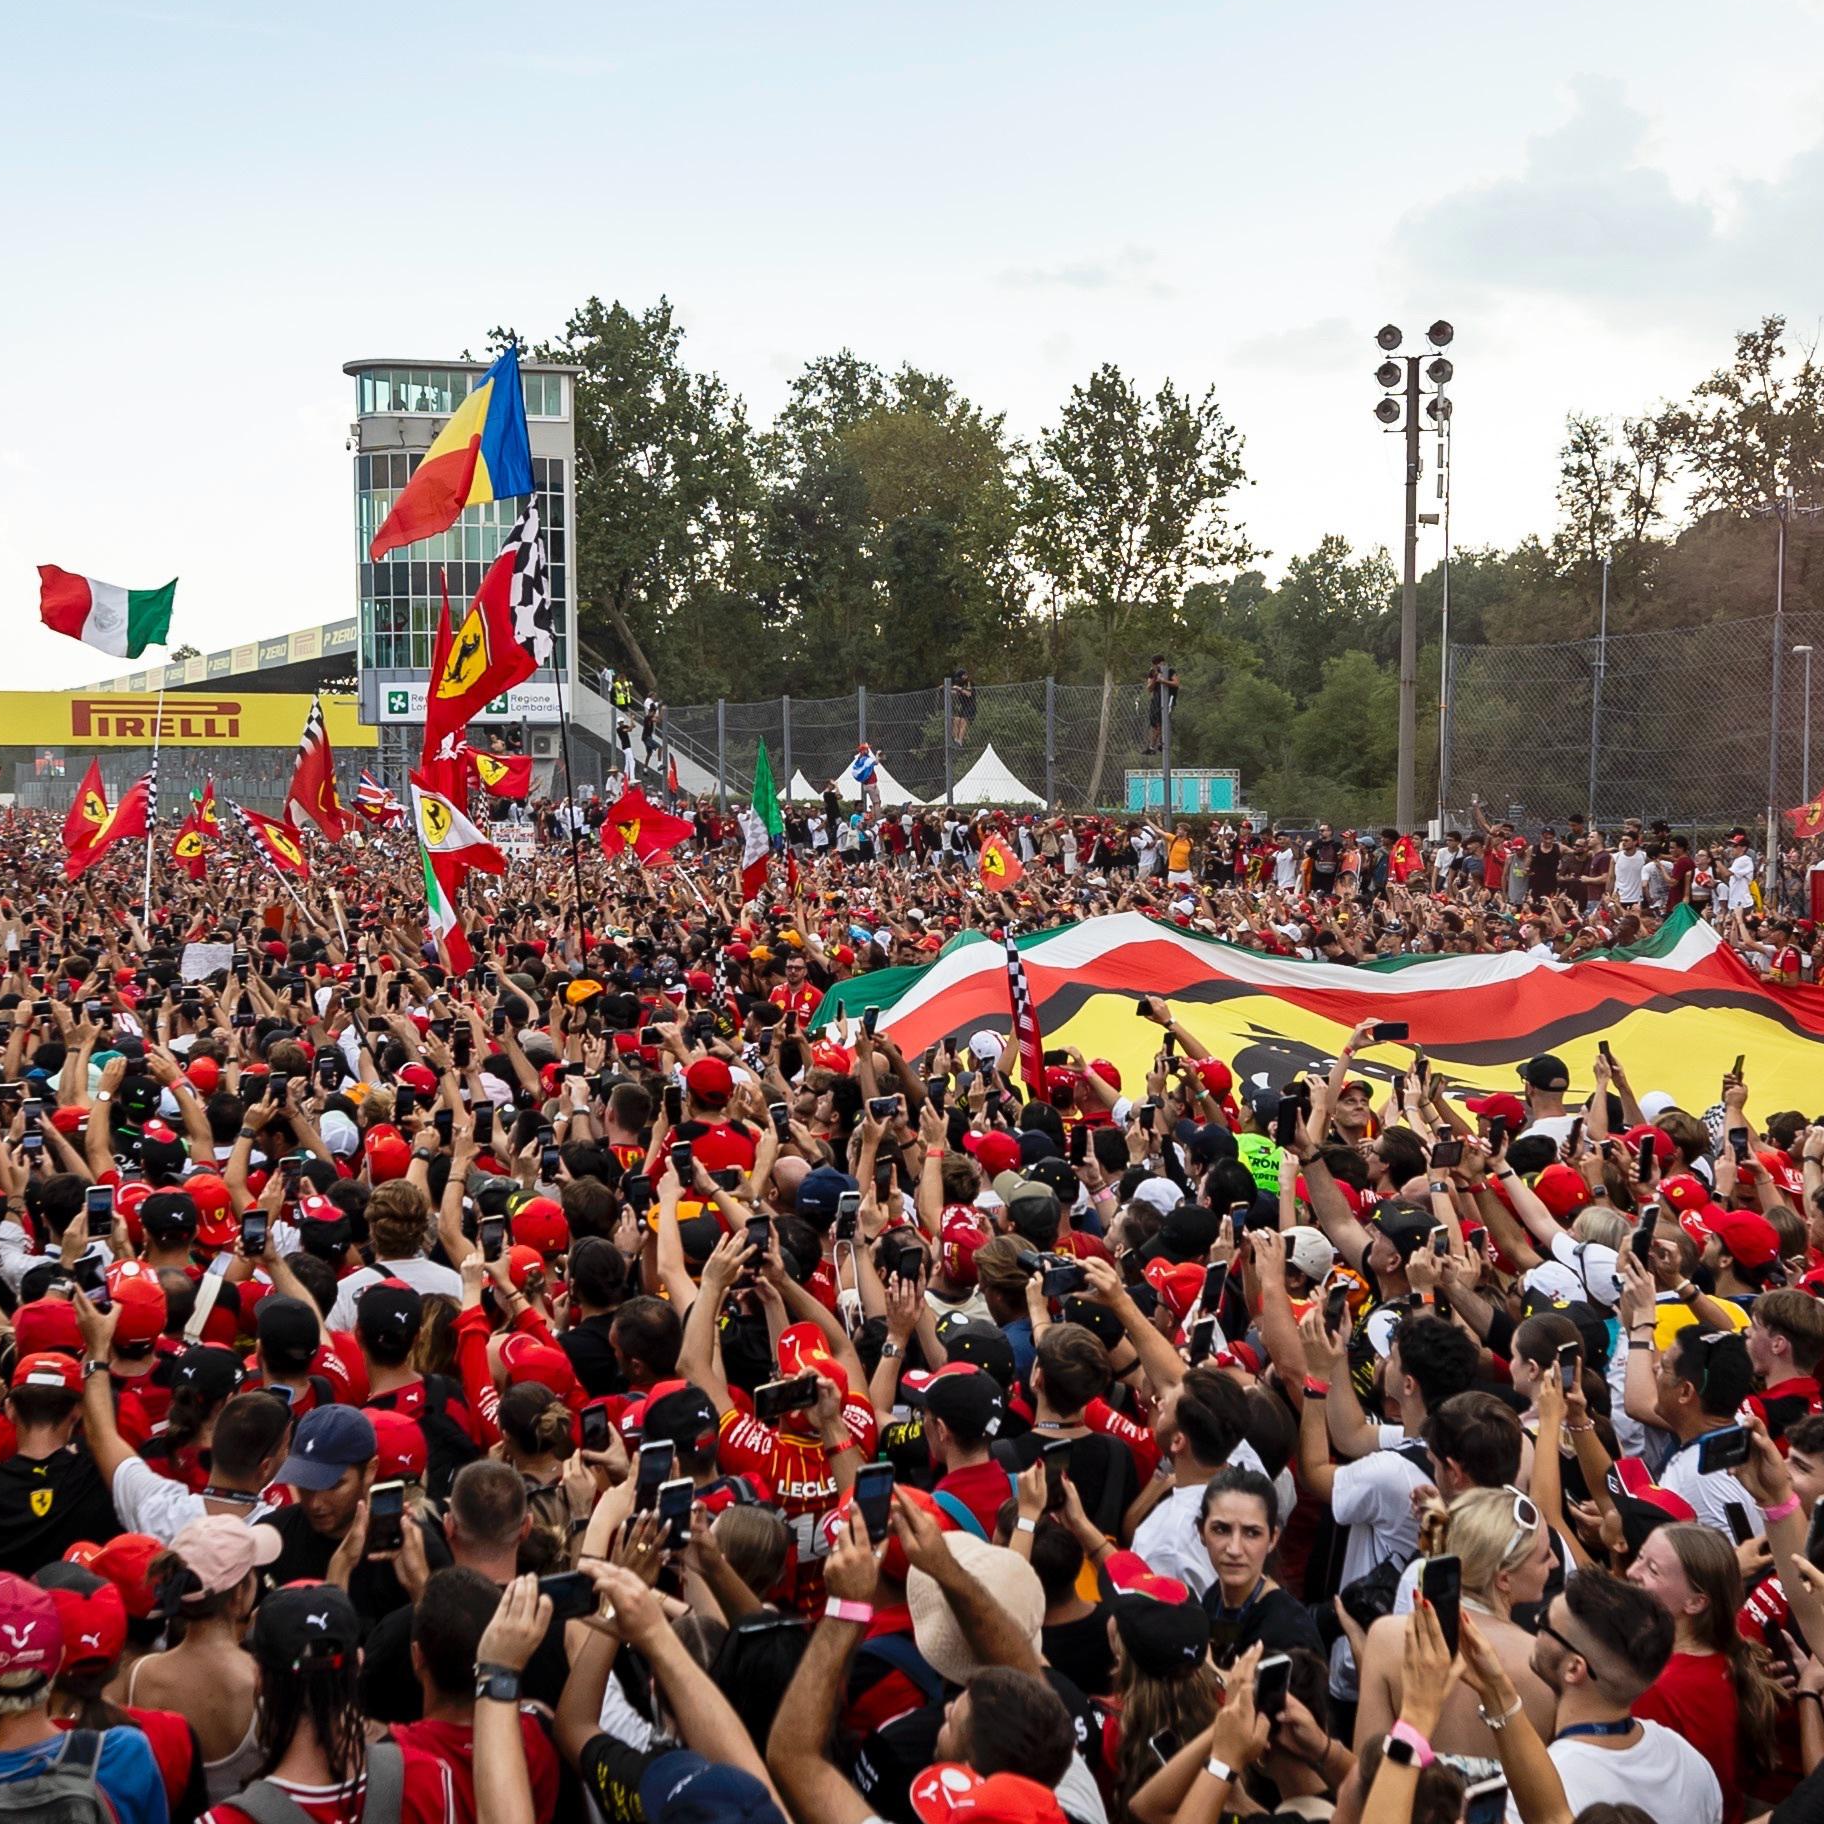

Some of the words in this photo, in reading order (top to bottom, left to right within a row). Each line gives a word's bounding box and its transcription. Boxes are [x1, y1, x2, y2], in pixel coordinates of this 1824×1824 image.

[331, 626, 357, 645] ZERO
[266, 643, 286, 658] ZERO
[511, 694, 551, 706] Regione
[511, 703, 561, 713] Lombardia
[71, 700, 242, 738] PIRELLI
[777, 1477, 838, 1498] LECLE
